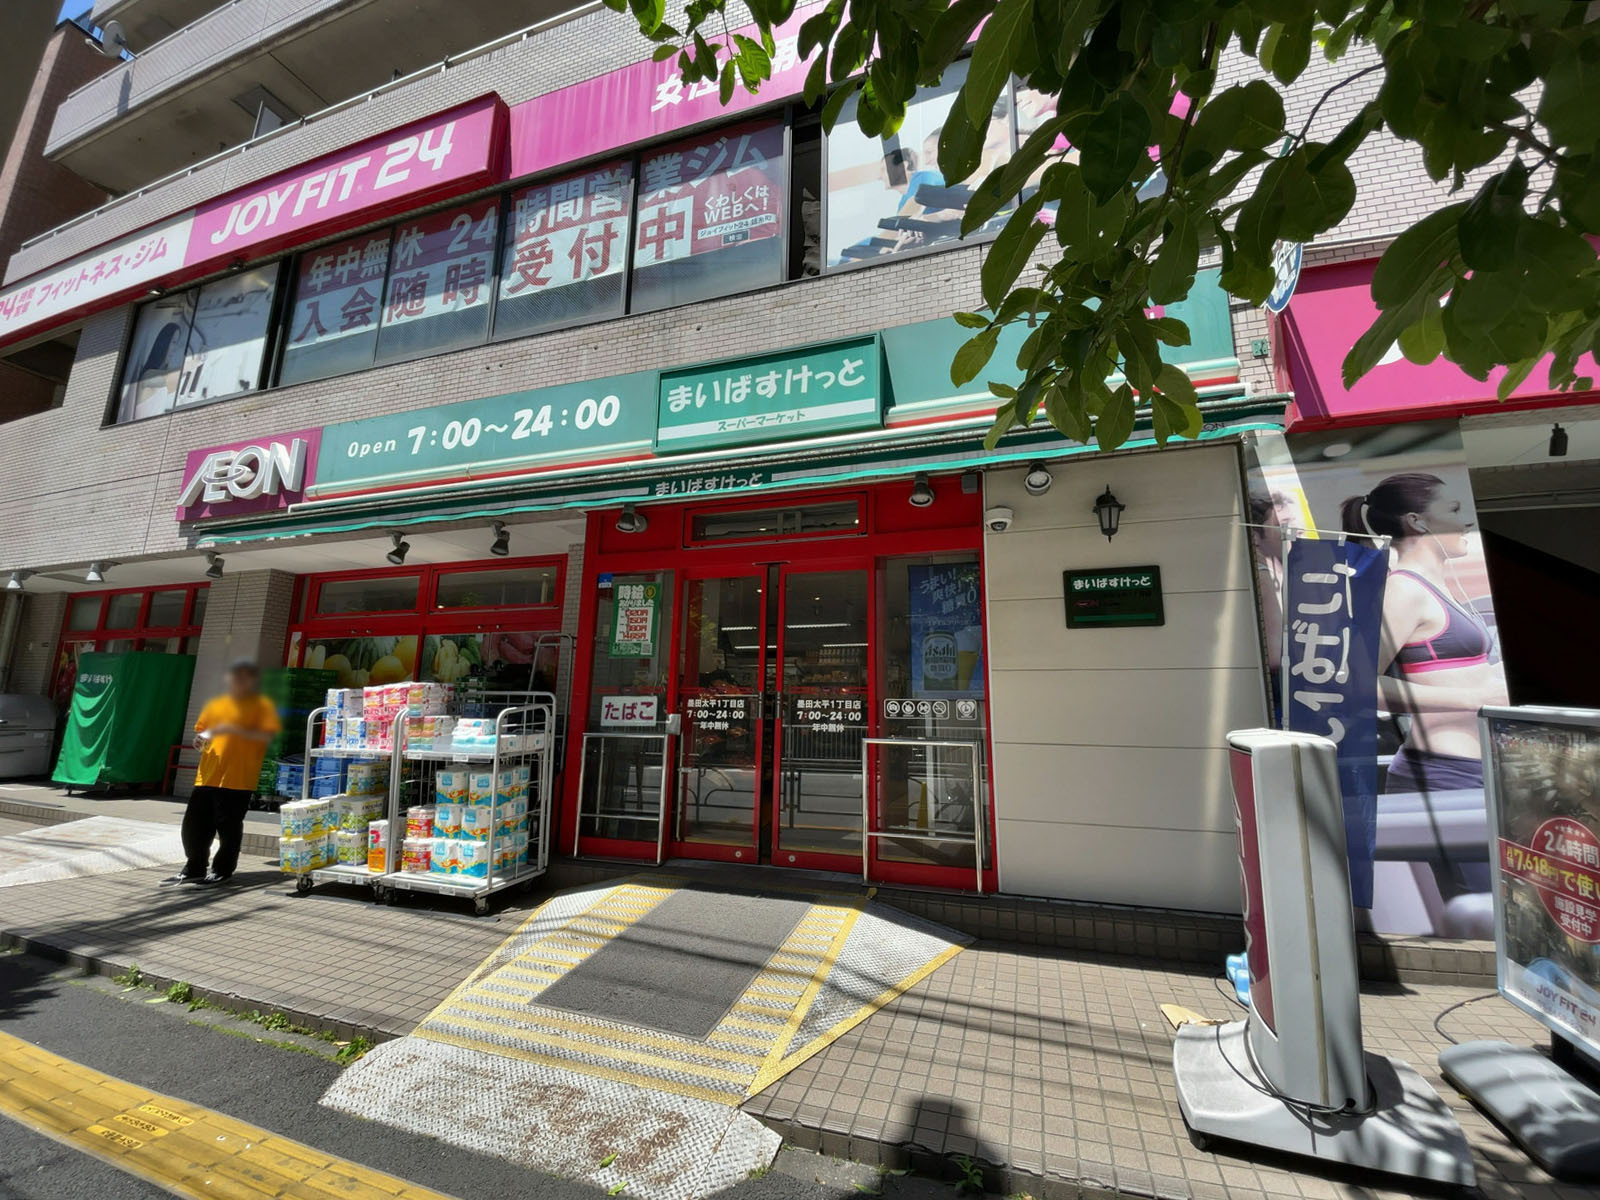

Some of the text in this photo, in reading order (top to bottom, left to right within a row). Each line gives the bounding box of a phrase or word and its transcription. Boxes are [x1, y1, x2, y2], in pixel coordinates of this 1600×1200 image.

[374, 121, 456, 190] 24
[704, 185, 770, 210] くわしくは
[37, 236, 168, 307] フィットネス・ジム
[309, 226, 425, 293] 年中無休
[294, 206, 684, 343] 入会随時受付中
[667, 358, 866, 413] まいばすけっと
[717, 410, 806, 432] スーパーマーケット
[347, 438, 397, 458] Open
[655, 472, 763, 497] まいばすけっと
[1072, 576, 1152, 590] まいばすけっと
[604, 701, 655, 721] たばこ
[1543, 830, 1600, 869] 24時間
[1559, 913, 1593, 936] 受付中
